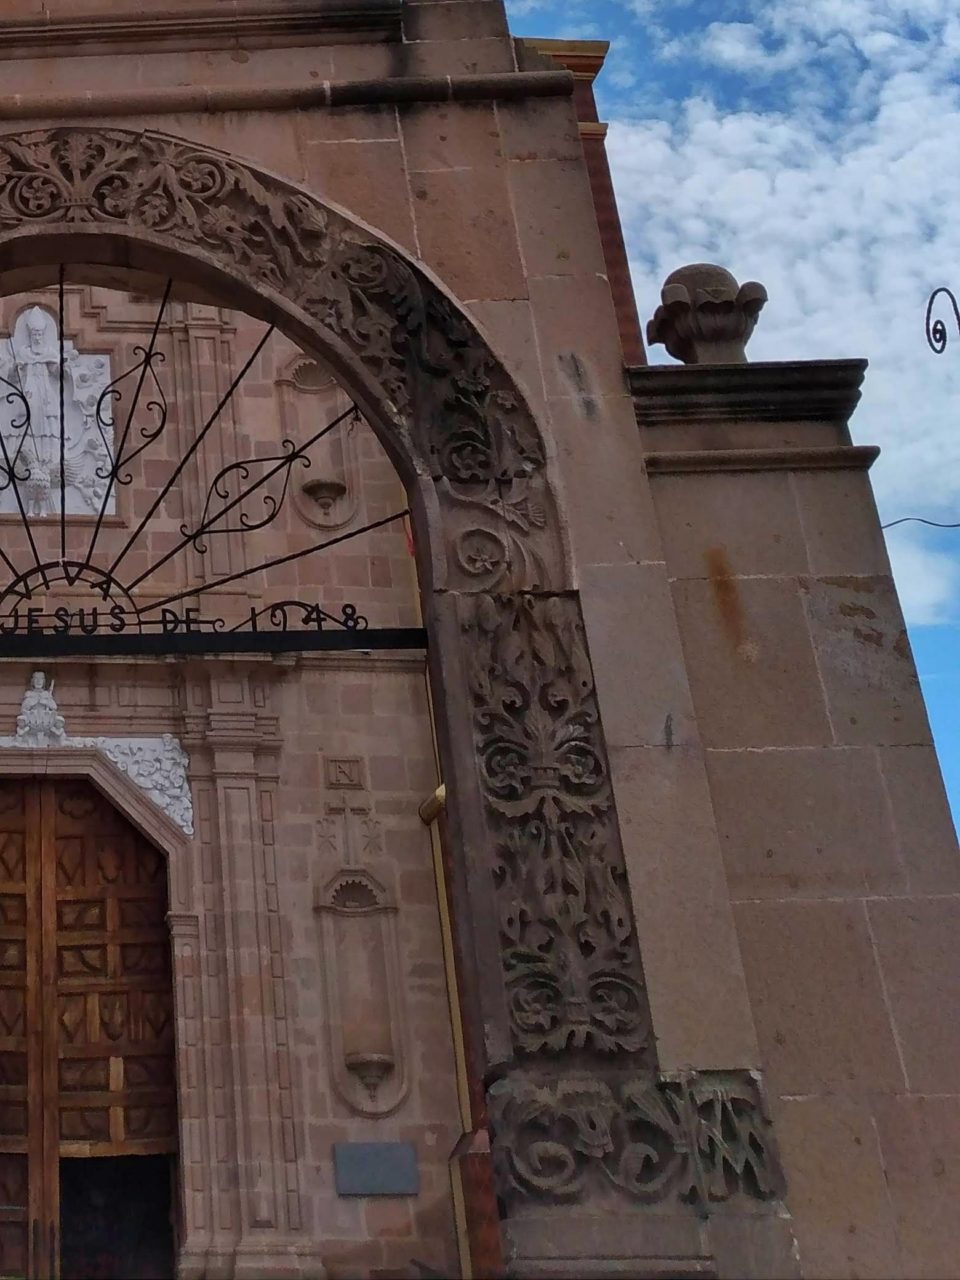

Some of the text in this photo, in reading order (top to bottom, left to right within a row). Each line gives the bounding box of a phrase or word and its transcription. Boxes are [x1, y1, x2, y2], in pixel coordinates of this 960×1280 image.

[0, 605, 126, 634] JESUS
[161, 607, 200, 633] DE
[249, 603, 357, 632] 1948
